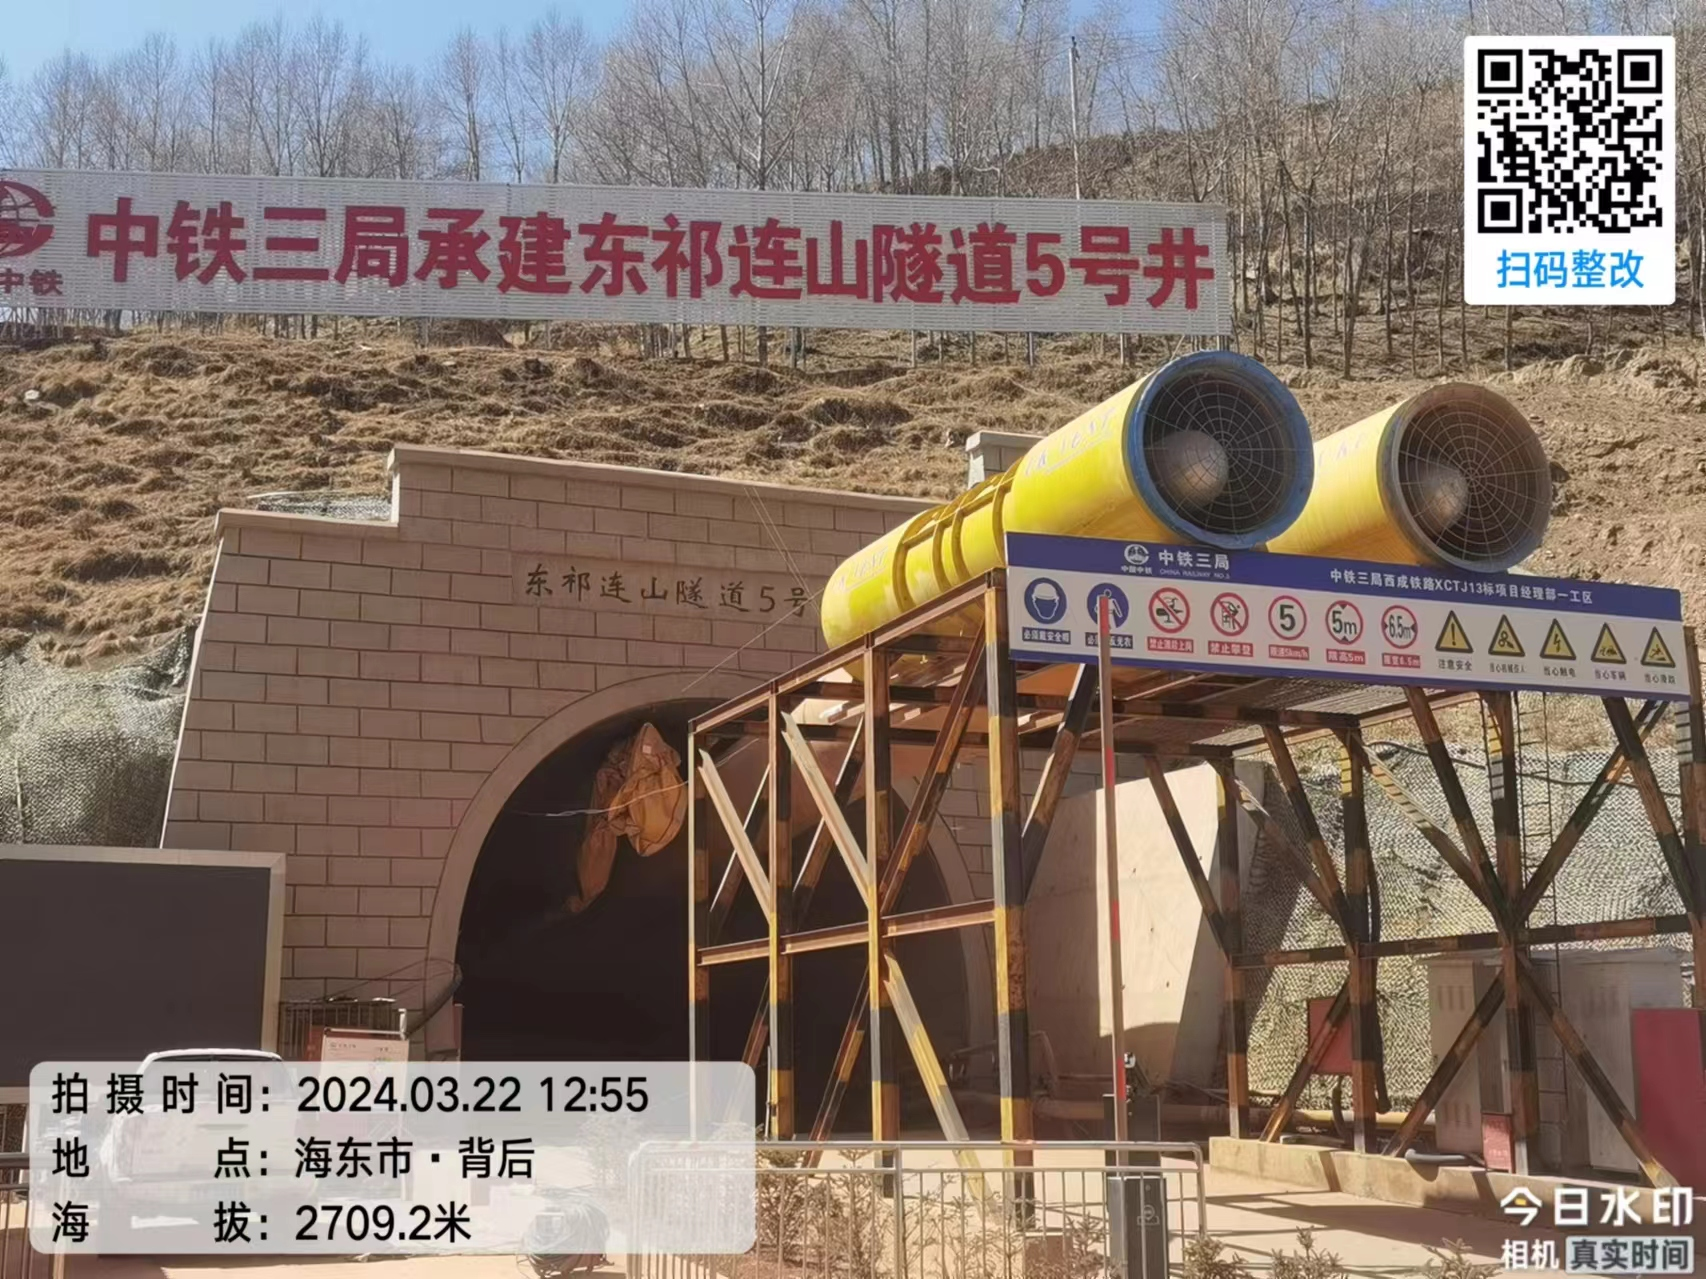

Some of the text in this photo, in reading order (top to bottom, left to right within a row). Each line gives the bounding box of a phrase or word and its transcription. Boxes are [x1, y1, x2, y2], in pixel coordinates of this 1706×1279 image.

[87, 195, 1216, 310] 中铁三局承建东祁连山隧道5号井
[1158, 549, 1230, 571] 中铁三局
[1159, 568, 1181, 576] CHINA
[1182, 570, 1211, 578] RAILWAY
[525, 563, 809, 618] 东祁连山隧道5号
[1330, 568, 1593, 605] 中铁三局西成铁路XCTJ13标项目经理部一工区
[1279, 604, 1296, 631] 5
[1331, 610, 1358, 635] 5m
[1388, 614, 1412, 640] 6.5m
[1327, 650, 1364, 663] 限高5m
[1438, 658, 1473, 671] 注意安全
